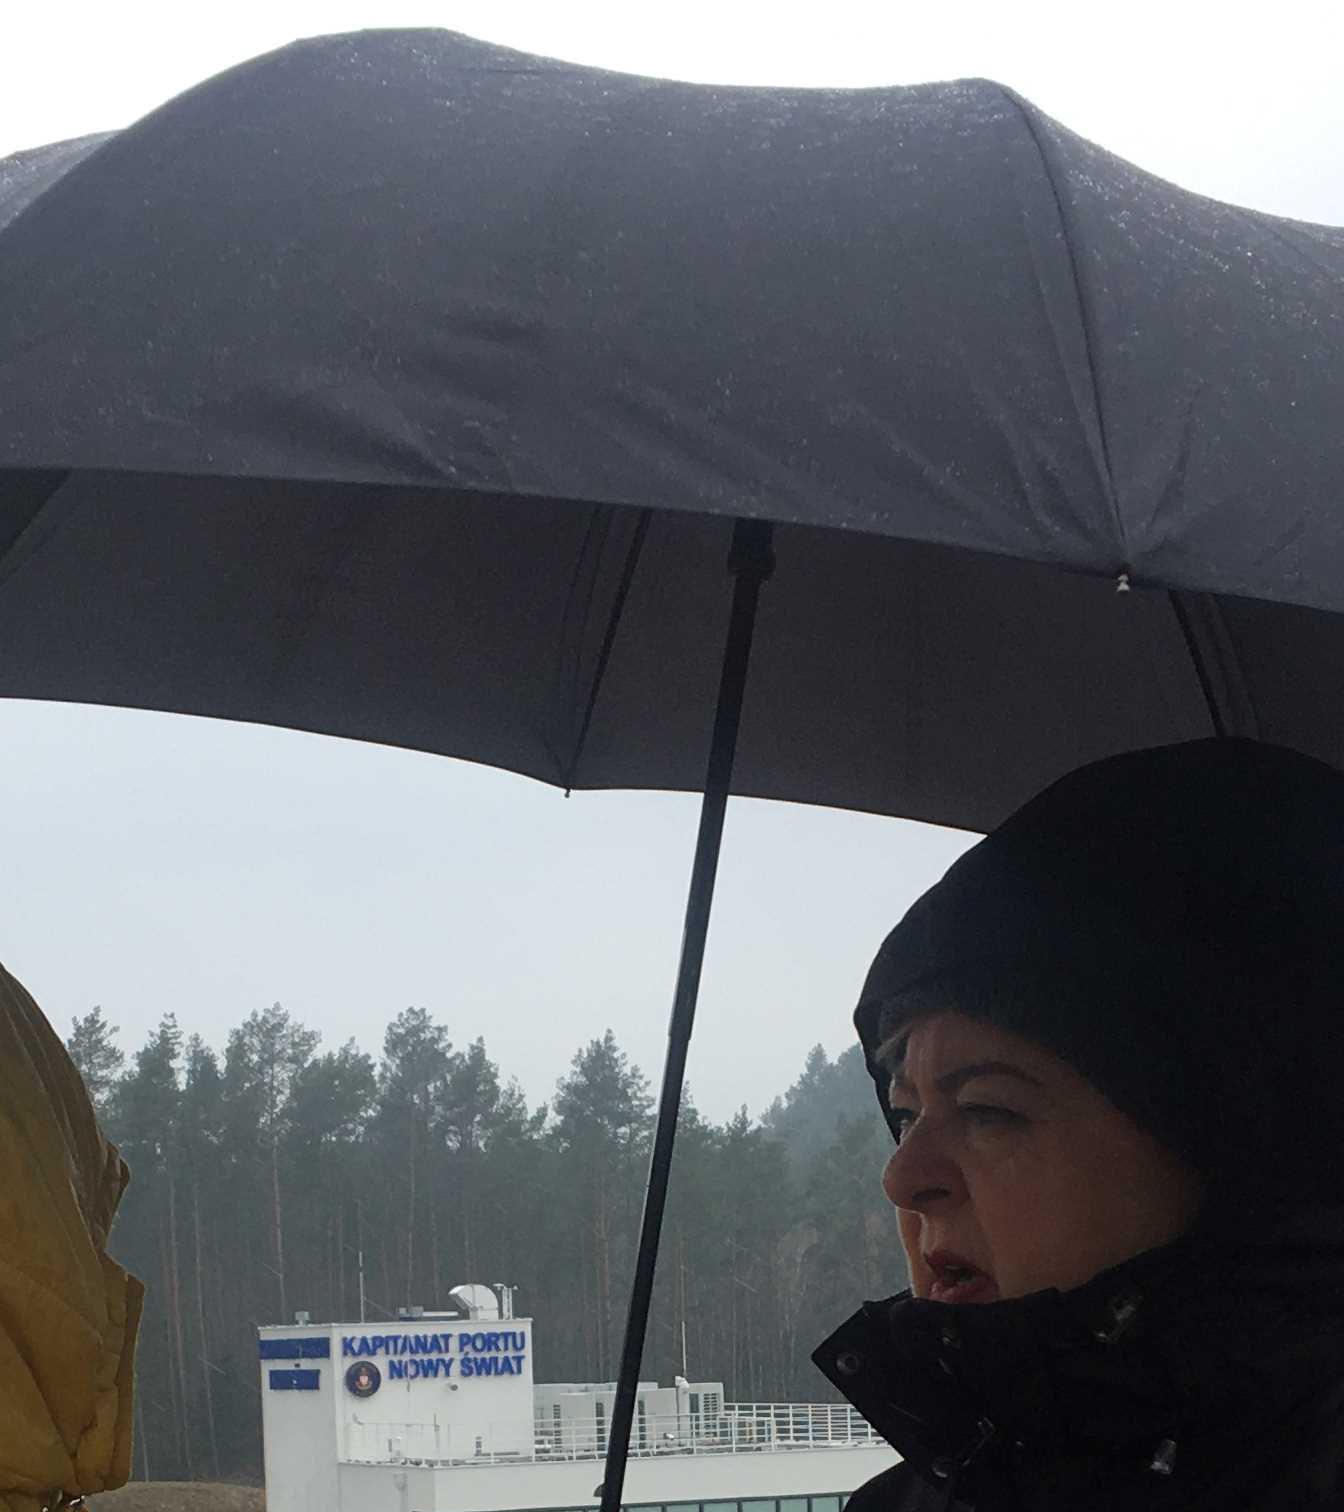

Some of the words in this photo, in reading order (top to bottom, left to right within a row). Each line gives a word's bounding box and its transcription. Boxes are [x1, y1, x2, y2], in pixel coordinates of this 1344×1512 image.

[343, 1334, 452, 1356] KAPITANAT
[459, 1331, 525, 1351] PORTU
[389, 1359, 452, 1379] NOWY
[460, 1351, 525, 1376] ŚWIAT
